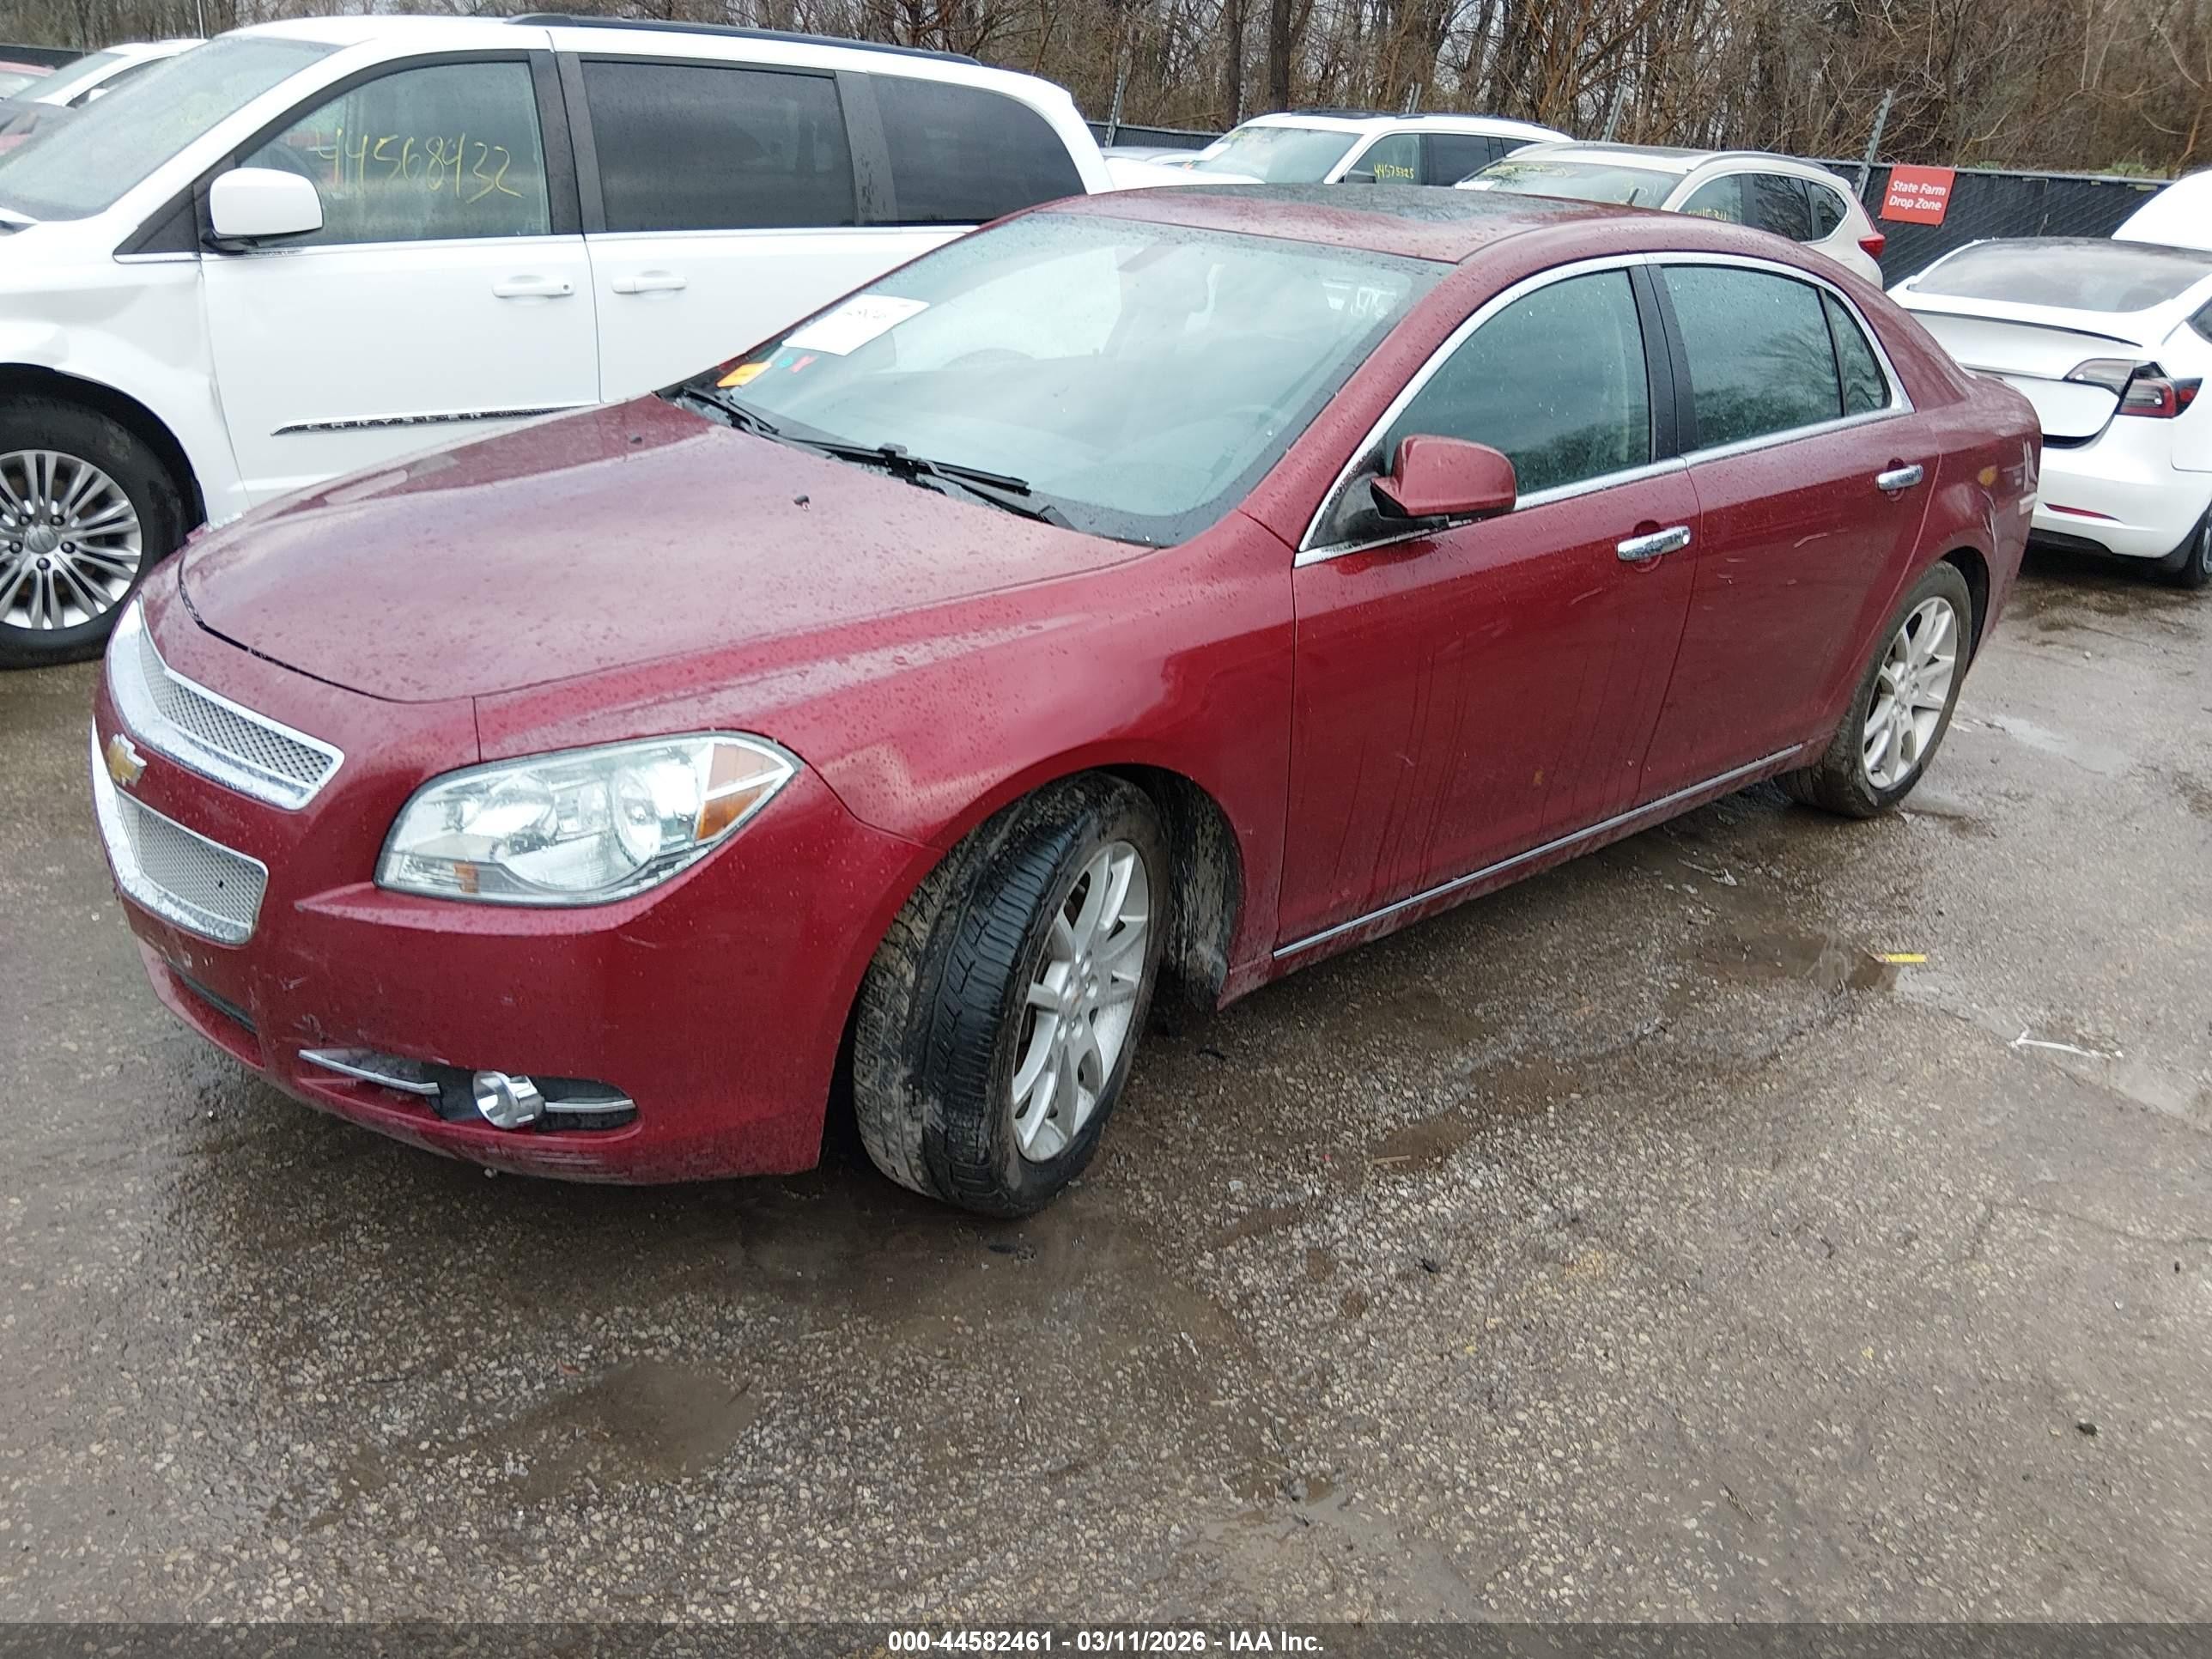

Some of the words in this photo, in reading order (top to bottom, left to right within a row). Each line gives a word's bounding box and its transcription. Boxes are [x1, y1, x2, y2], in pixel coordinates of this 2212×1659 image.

[1892, 179, 1918, 193] State
[1919, 182, 1947, 196] Farm
[1888, 195, 1914, 210] Drop
[1915, 198, 1942, 210] Zone
[307, 411, 482, 430] CHRYSLER
